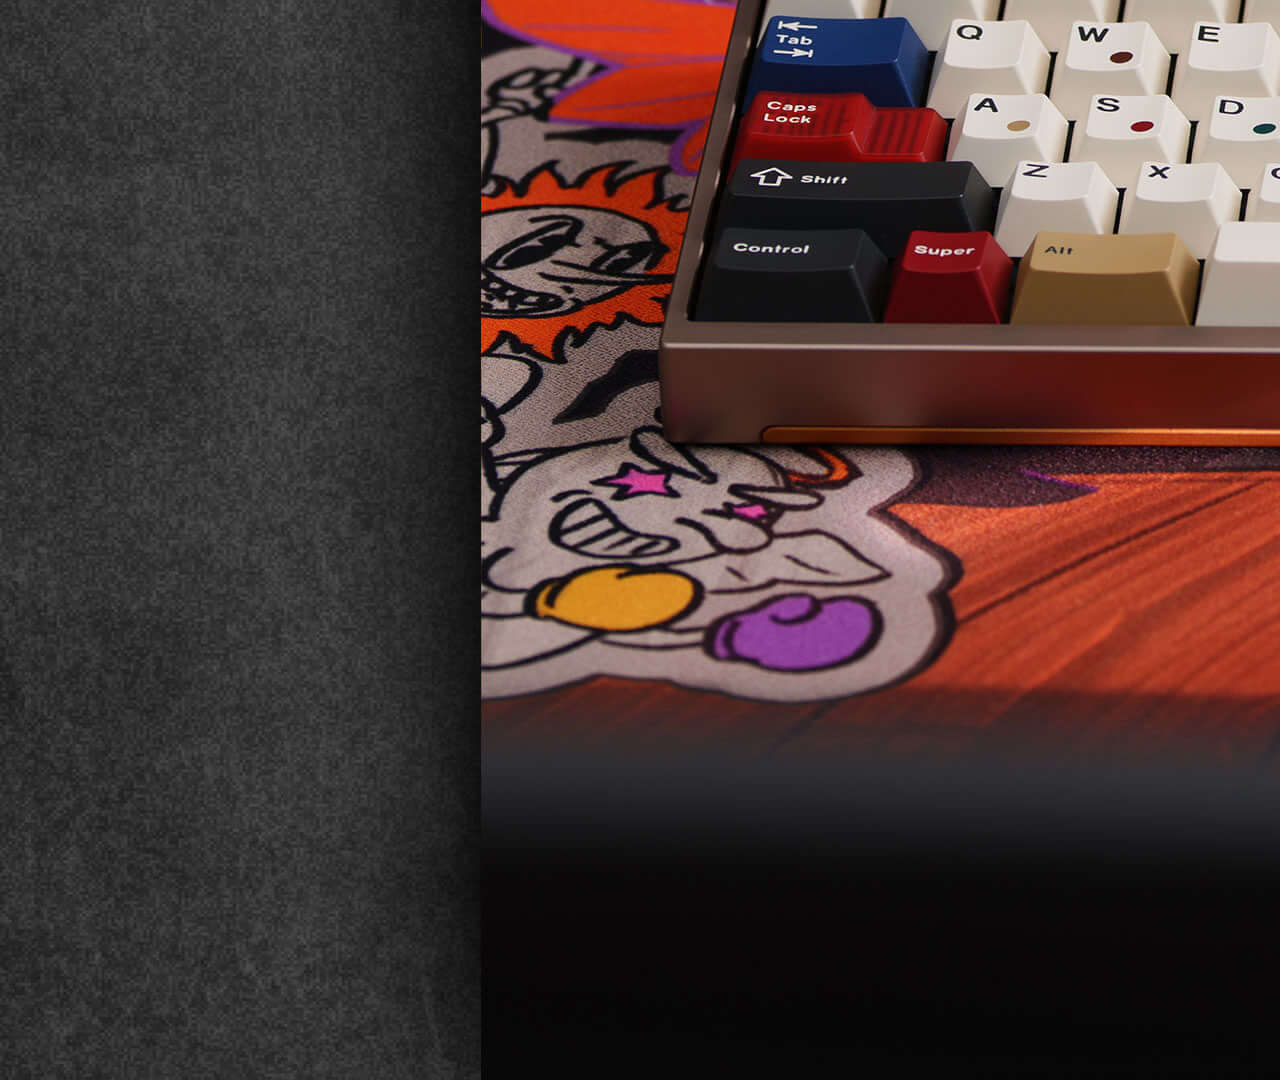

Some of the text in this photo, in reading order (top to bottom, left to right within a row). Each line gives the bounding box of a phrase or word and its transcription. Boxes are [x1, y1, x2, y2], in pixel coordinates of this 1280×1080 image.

[775, 34, 813, 46] Tab
[956, 24, 984, 41] Q
[1077, 26, 1109, 43] W
[1197, 25, 1221, 43] E
[765, 100, 817, 113] Caps
[973, 97, 999, 113] A
[1096, 97, 1120, 113] S
[1218, 99, 1245, 115] D
[763, 113, 811, 124] Lock
[1022, 163, 1050, 178] Z
[1148, 165, 1171, 180] X
[800, 175, 848, 185] Shift
[733, 242, 810, 254] Control
[914, 245, 975, 257] Super
[1044, 245, 1073, 255] Alt
